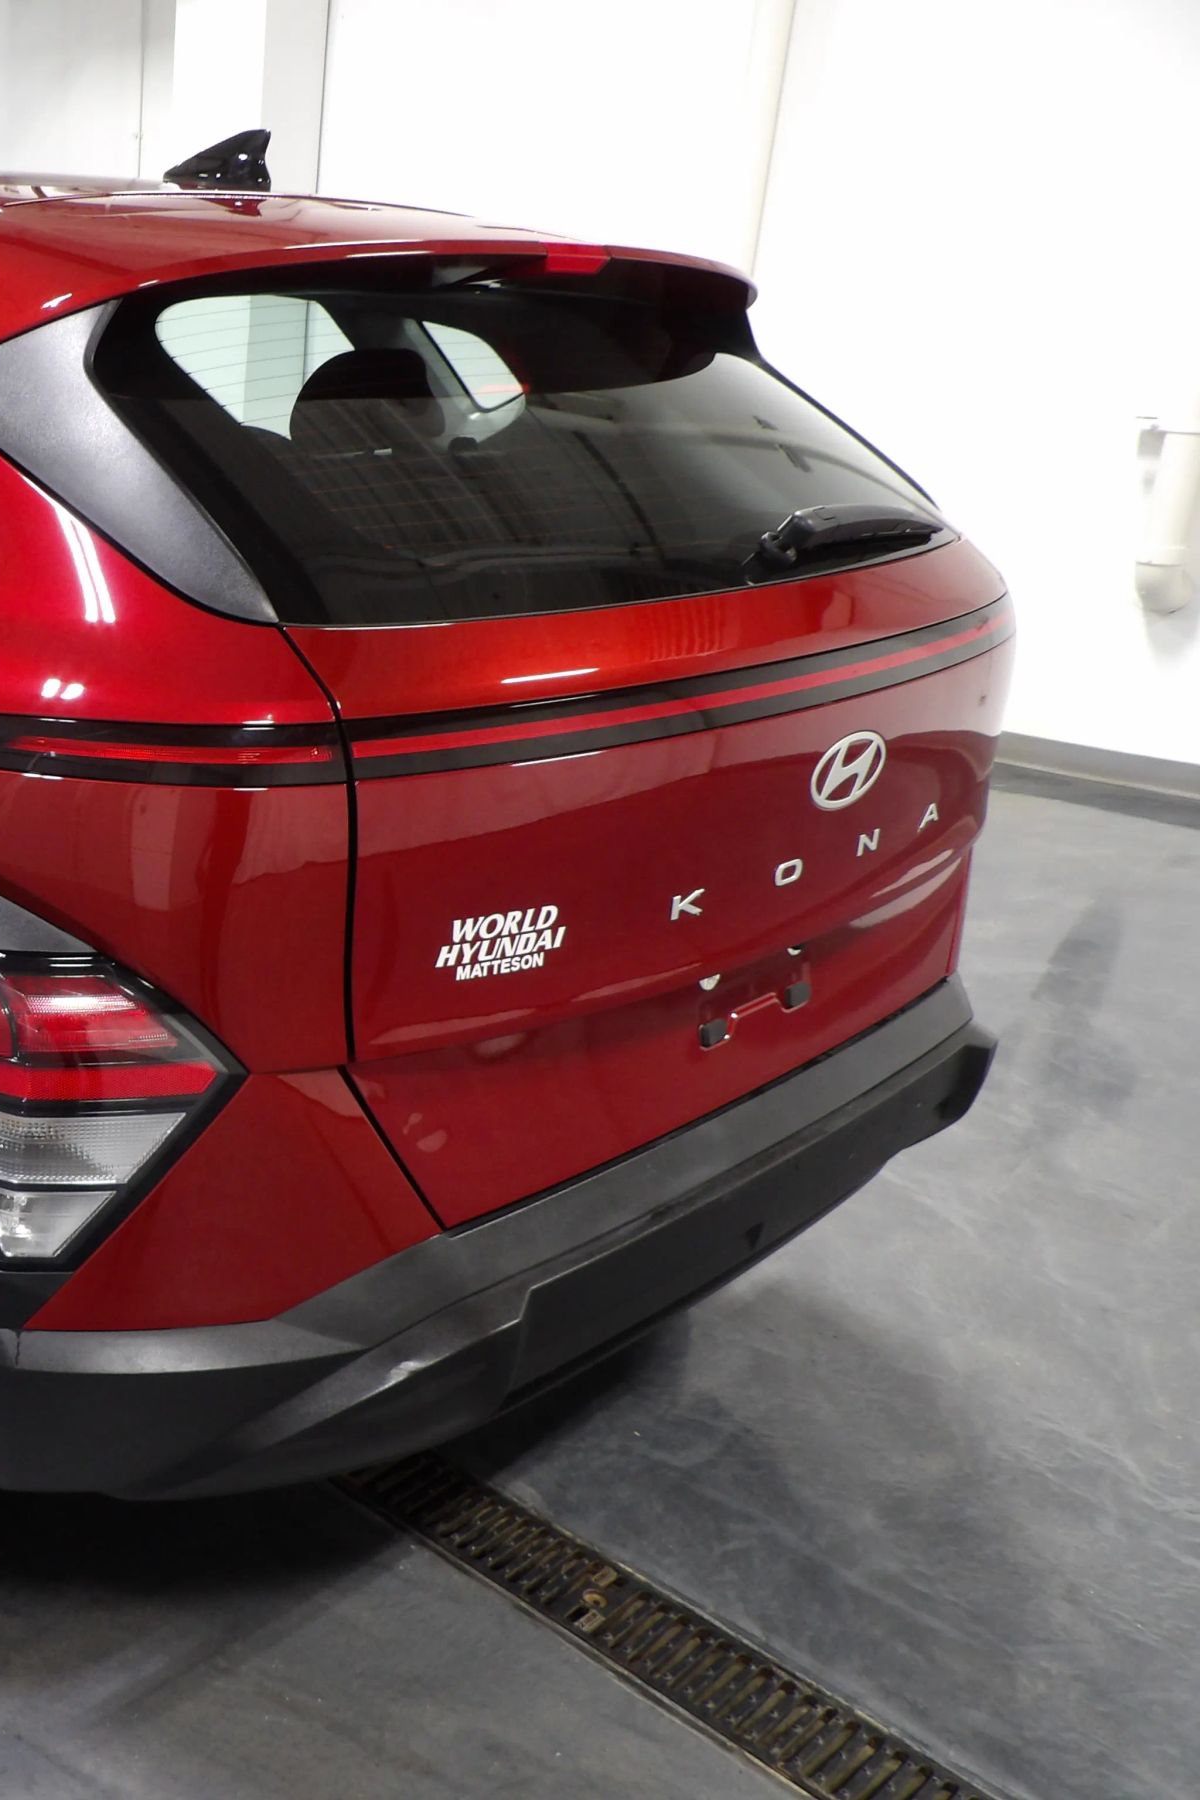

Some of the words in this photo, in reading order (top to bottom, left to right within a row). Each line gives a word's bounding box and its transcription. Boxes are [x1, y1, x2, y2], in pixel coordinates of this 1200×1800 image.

[669, 802, 939, 921] KONA
[452, 905, 559, 943] WORLD
[435, 926, 567, 968] HYUNDAI
[455, 951, 545, 981] MATTESON
